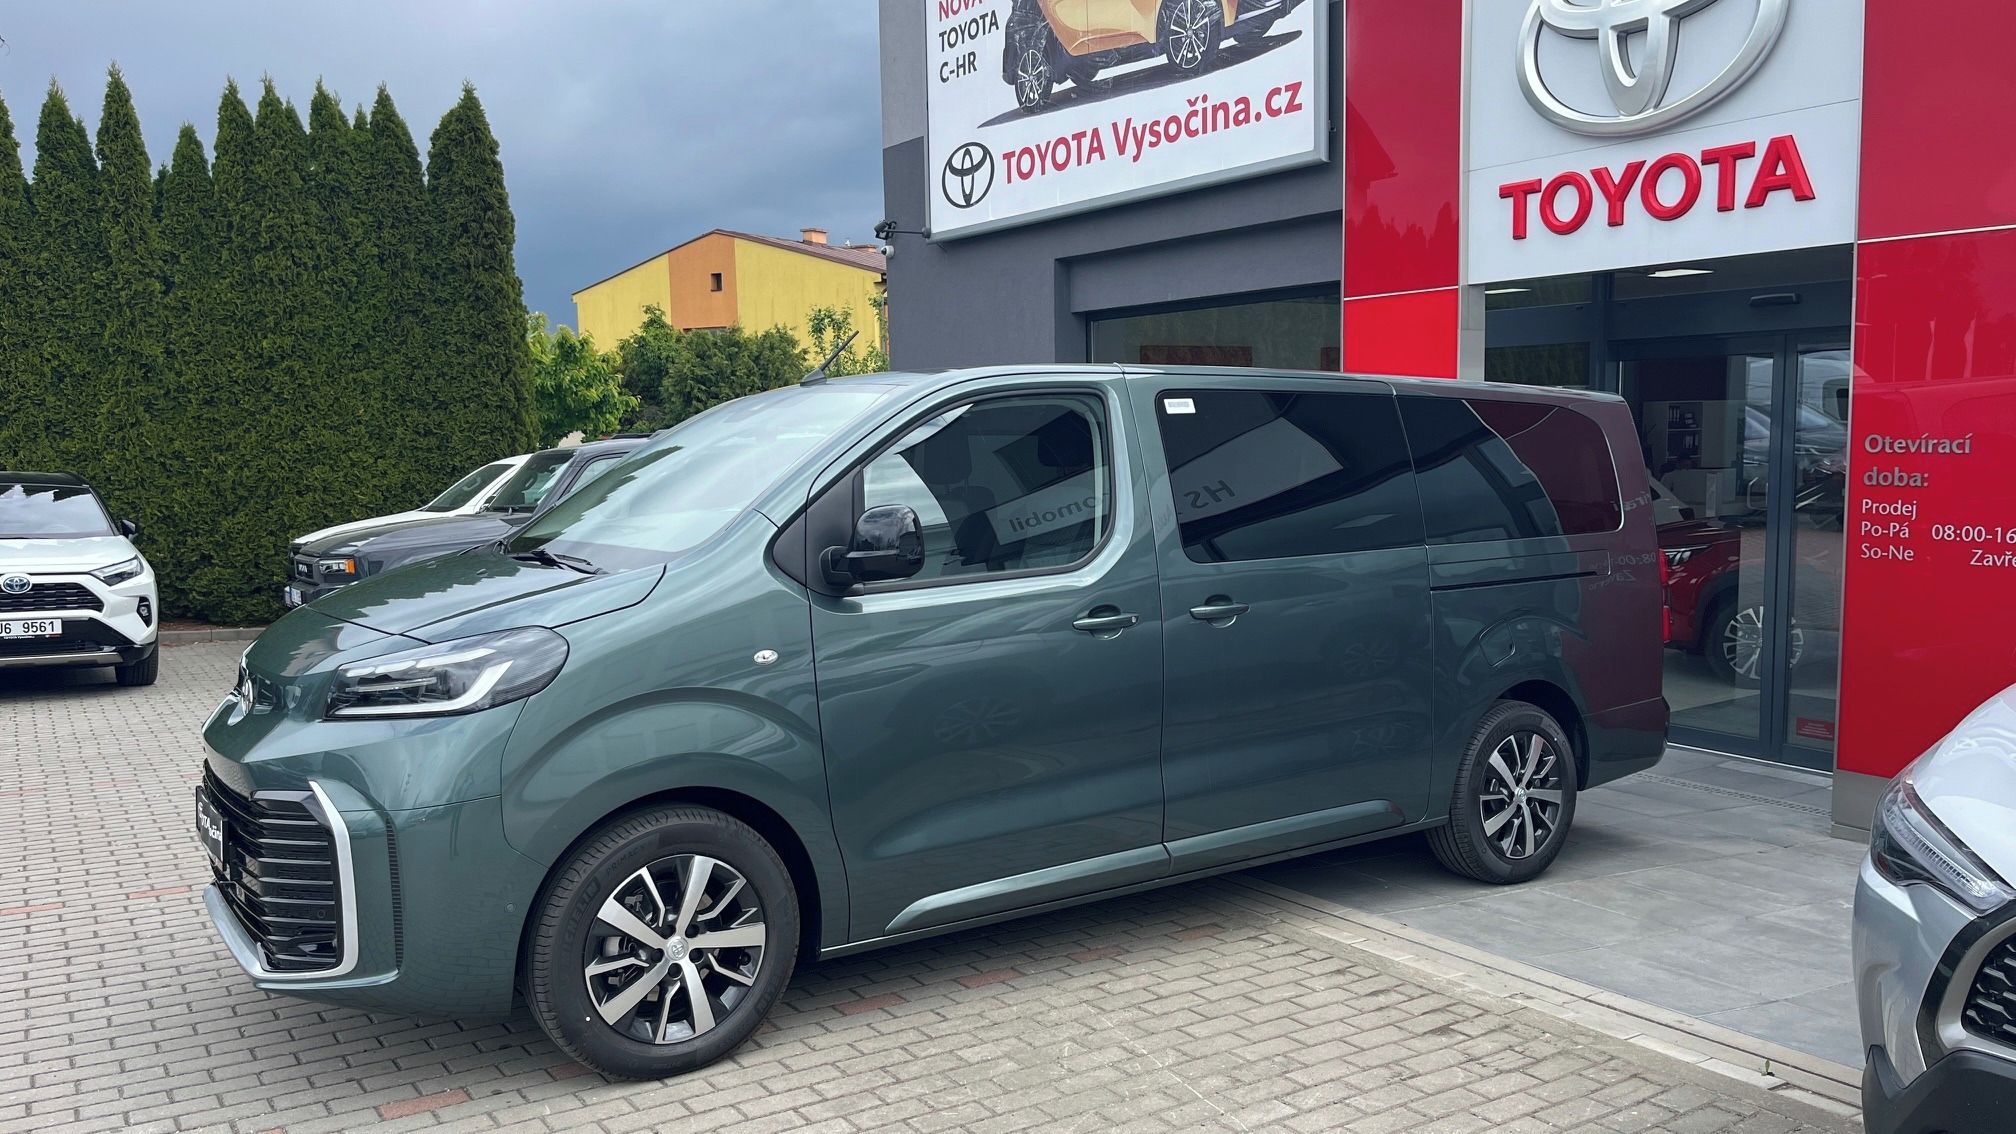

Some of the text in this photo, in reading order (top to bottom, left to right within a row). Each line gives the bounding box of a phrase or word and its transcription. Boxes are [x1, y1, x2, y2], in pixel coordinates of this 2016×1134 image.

[938, 10, 999, 52] TOYOTA
[939, 51, 977, 83] C-HR
[1002, 80, 1303, 184] TOYOTA Vysočina.cz
[1498, 134, 1816, 240] TOYOTA
[1864, 433, 1973, 454] Otevírací
[1863, 467, 1929, 487] doba:
[1861, 499, 1917, 520] Prodej
[1861, 522, 1910, 538] Po-Pá
[1860, 543, 2016, 567] So-Ne Zavře
[22, 621, 55, 633] 9561
